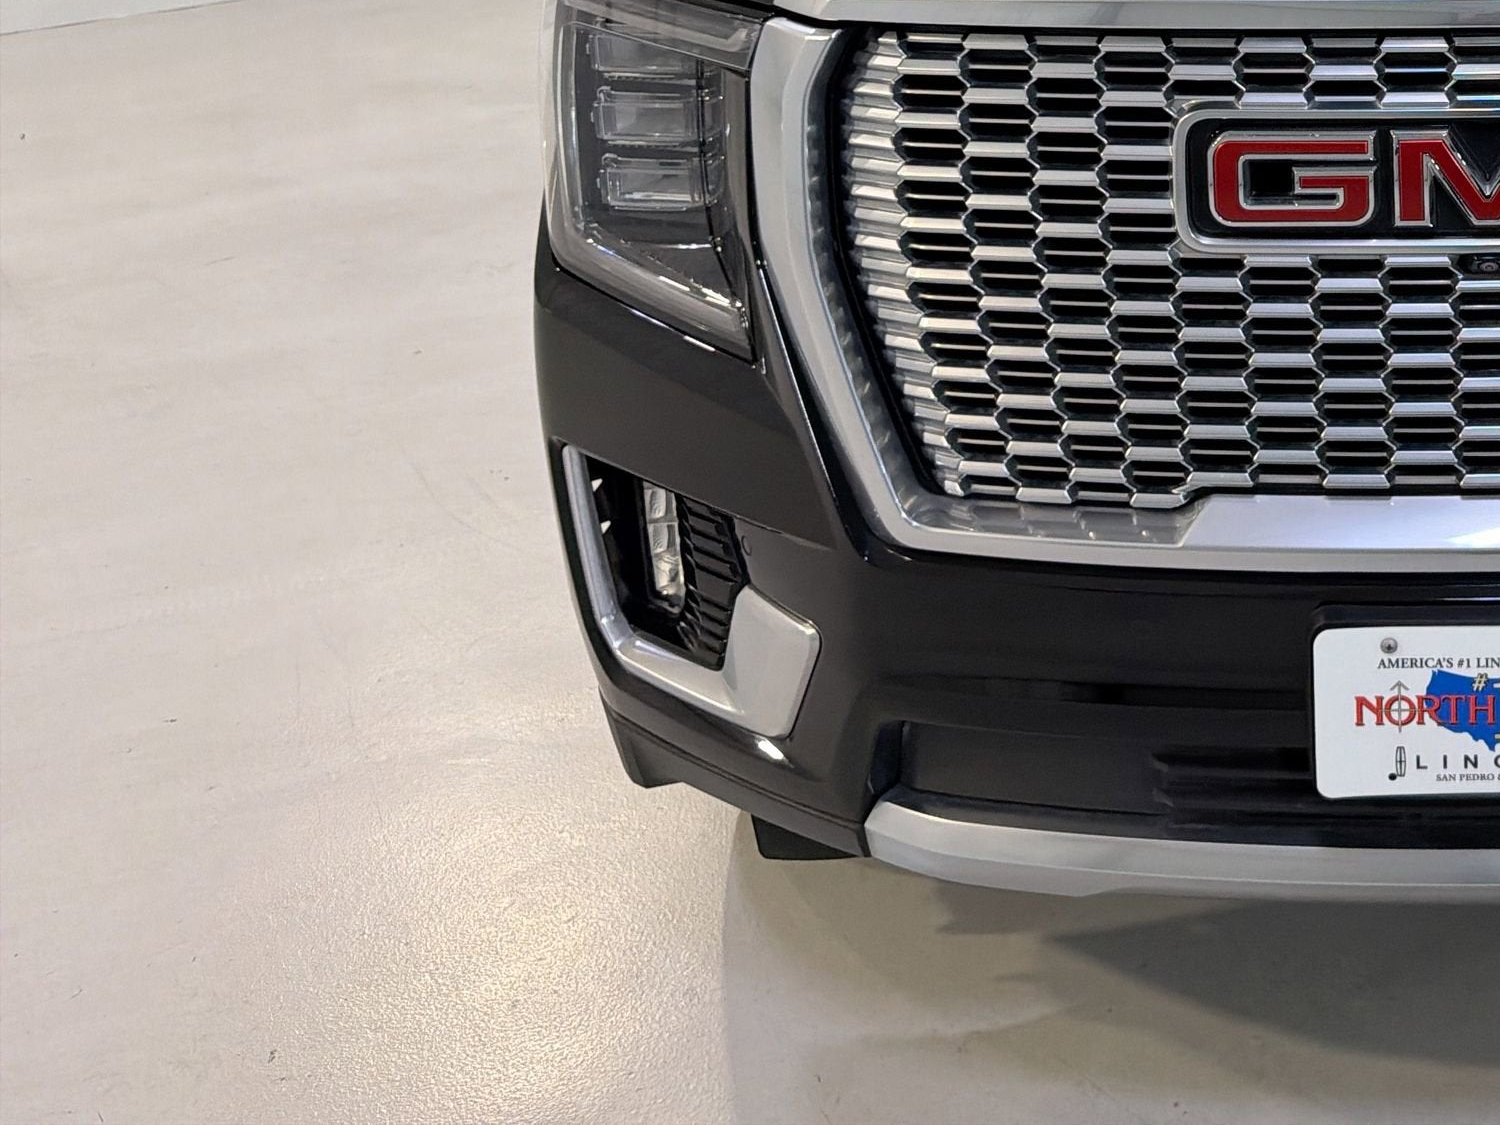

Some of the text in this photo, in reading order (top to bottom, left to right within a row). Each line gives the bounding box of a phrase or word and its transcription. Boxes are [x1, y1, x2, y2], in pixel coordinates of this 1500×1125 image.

[1377, 657, 1454, 669] AMERICA'S
[1457, 657, 1471, 668] #1
[1354, 694, 1496, 726] NORTH
[1436, 773, 1456, 782] SAN
[1459, 773, 1495, 782] PEDRO
